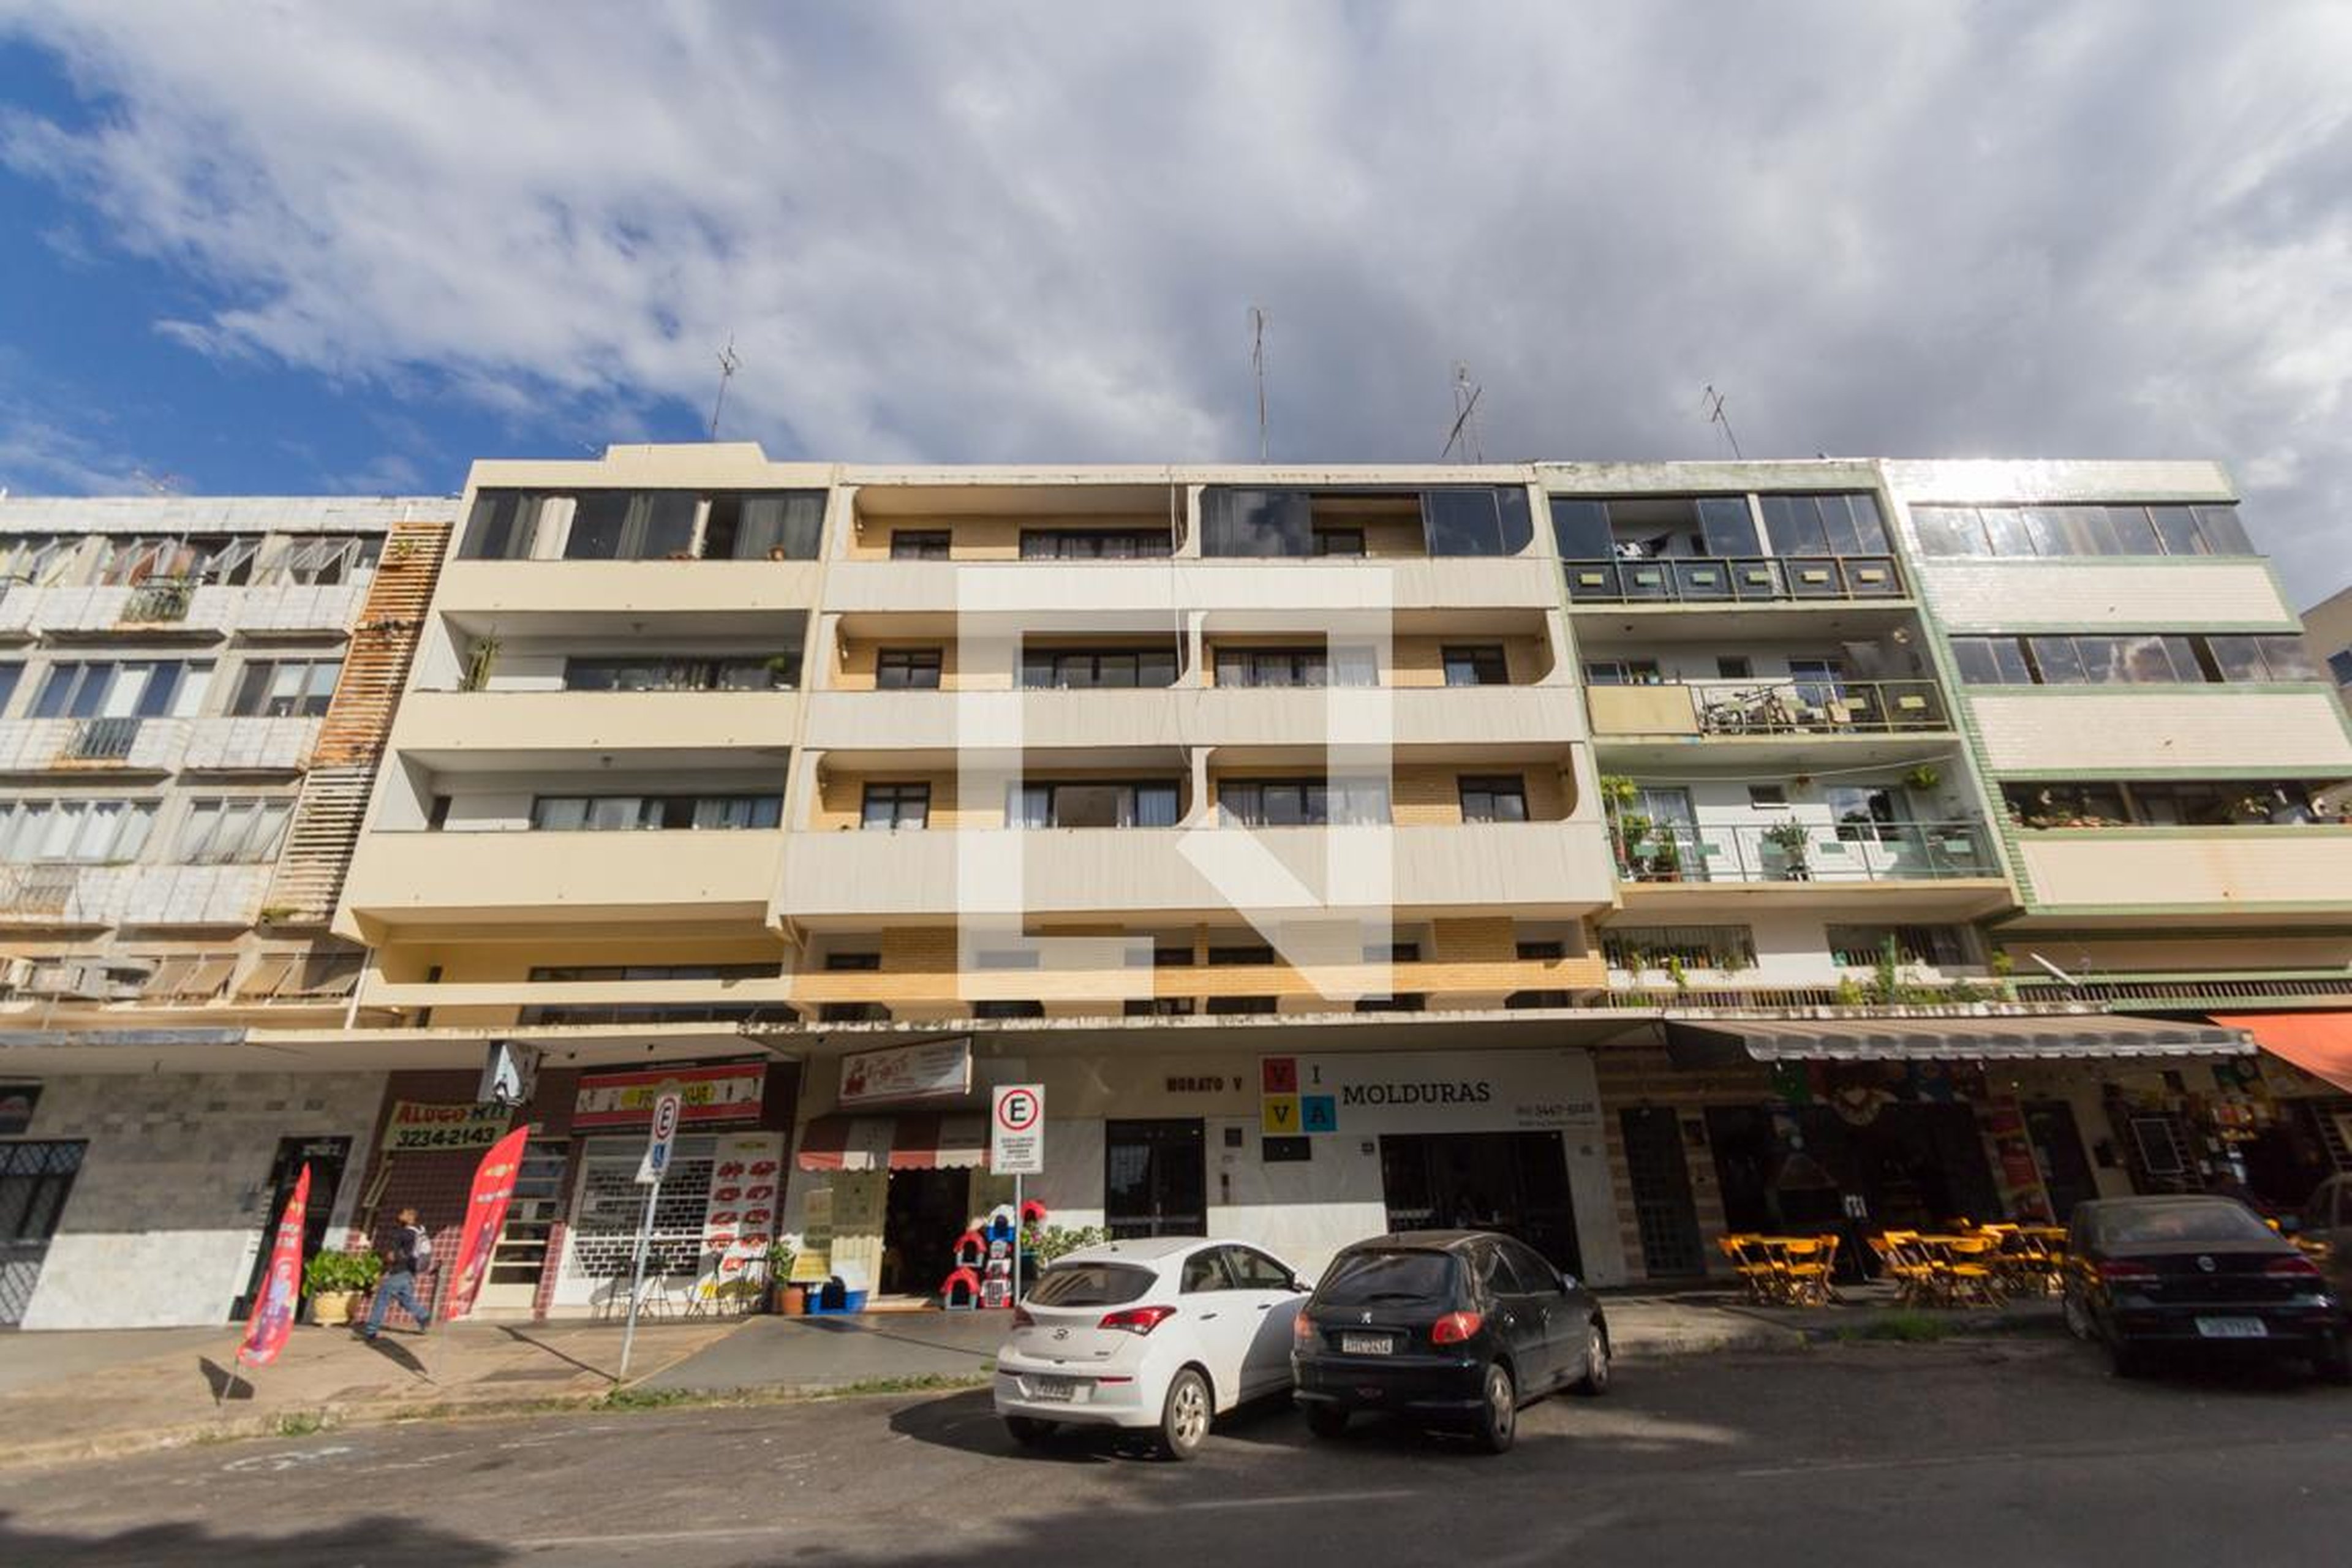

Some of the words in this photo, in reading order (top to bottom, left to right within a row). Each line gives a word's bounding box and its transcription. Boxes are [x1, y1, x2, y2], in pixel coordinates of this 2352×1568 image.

[1234, 1077, 1242, 1092] V
[1343, 1082, 1490, 1106] MOLDURAS
[397, 1105, 467, 1124] ALUGO
[660, 1106, 672, 1131] E
[1009, 1097, 1027, 1122] E
